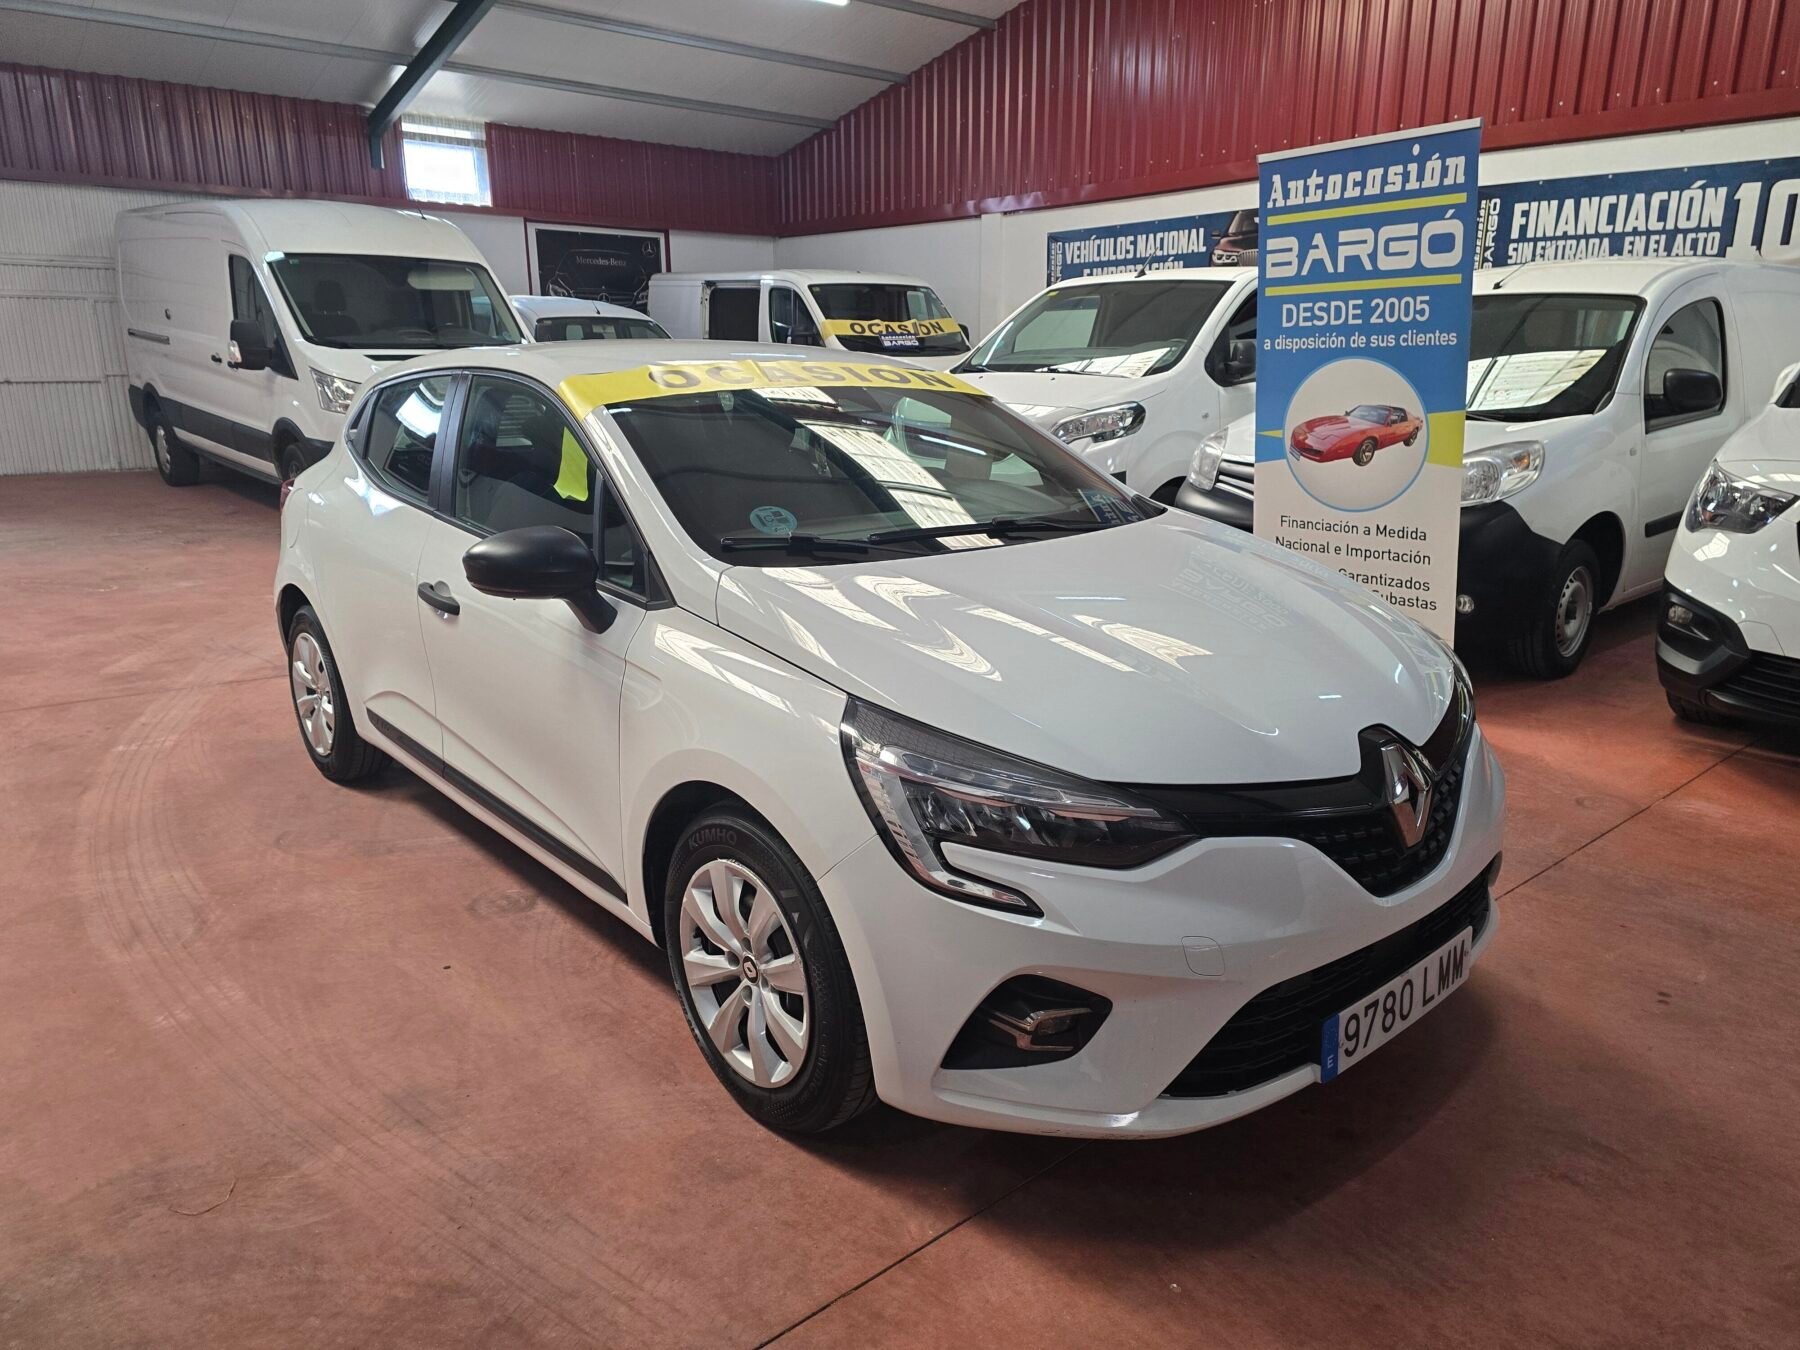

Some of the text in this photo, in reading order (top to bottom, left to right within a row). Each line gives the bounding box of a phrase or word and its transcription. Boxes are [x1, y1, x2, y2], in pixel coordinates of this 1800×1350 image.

[1267, 143, 1466, 208] Autocasión
[1510, 180, 1728, 240] FINANCIACIÓN
[1065, 234, 1135, 265] VEHÍCULOS
[1136, 228, 1207, 258] NACIONAL
[1266, 209, 1464, 279] BARGÓ
[1507, 242, 1534, 264] SIN
[1623, 235, 1646, 258] EN
[1651, 234, 1669, 258] EL
[1671, 231, 1721, 257] ACTO
[576, 255, 627, 267] Mercedes-Benz
[1282, 295, 1430, 328] DESDE 2005
[1264, 330, 1457, 353] a disposición de sus clientes
[649, 364, 955, 389] OCASION
[1280, 515, 1427, 541] Financiación a Medida
[1275, 536, 1431, 566] Nacional e Importación
[688, 827, 737, 850] KUMHO
[1344, 939, 1465, 1058] 9780 LMM
[1327, 1054, 1335, 1069] E
